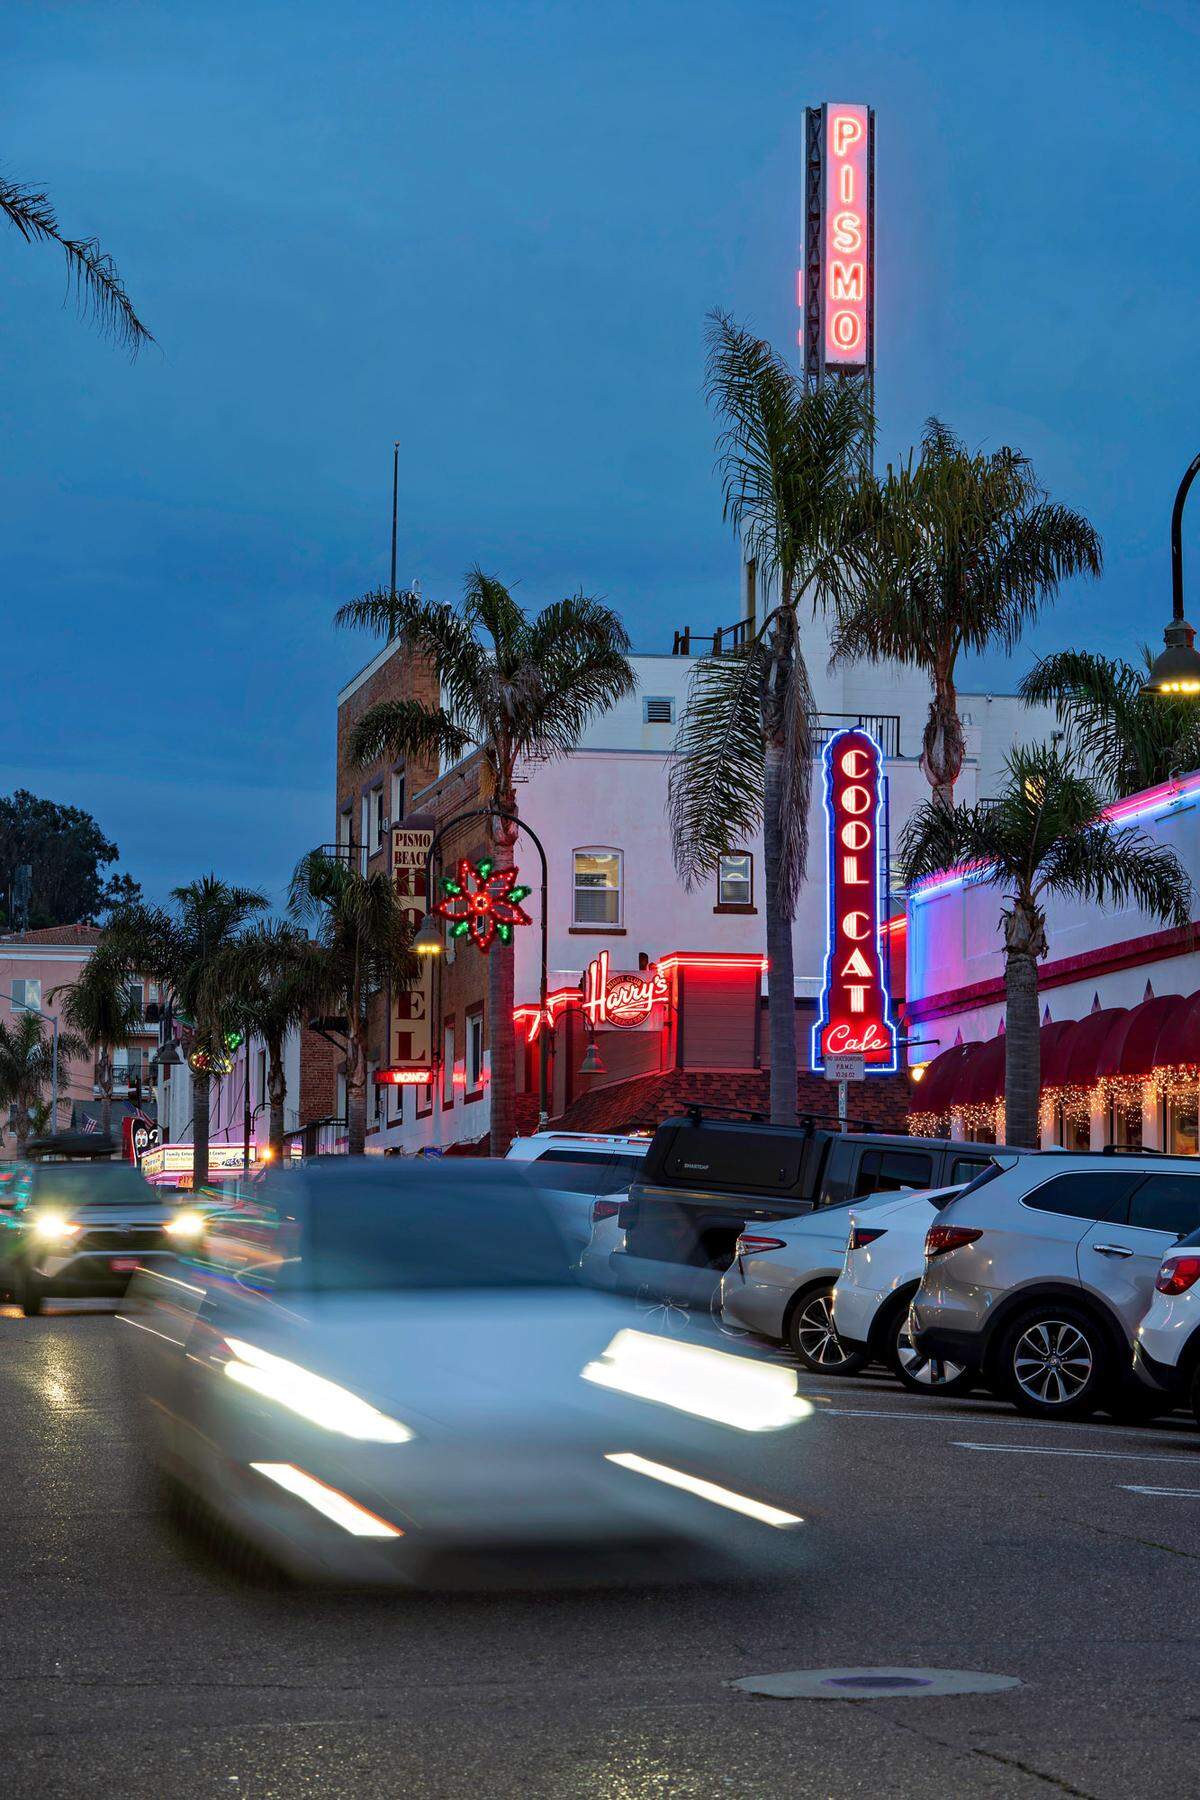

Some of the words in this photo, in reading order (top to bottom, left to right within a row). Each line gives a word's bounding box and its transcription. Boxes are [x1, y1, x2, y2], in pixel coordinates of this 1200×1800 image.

[831, 116, 863, 349] PISMO
[395, 833, 431, 848] PISMO
[841, 749, 871, 884] COOL
[582, 950, 668, 1024] Harry's
[841, 911, 873, 1012] CAT
[827, 1024, 888, 1053] Cafe
[393, 1071, 430, 1083] VACANCY
